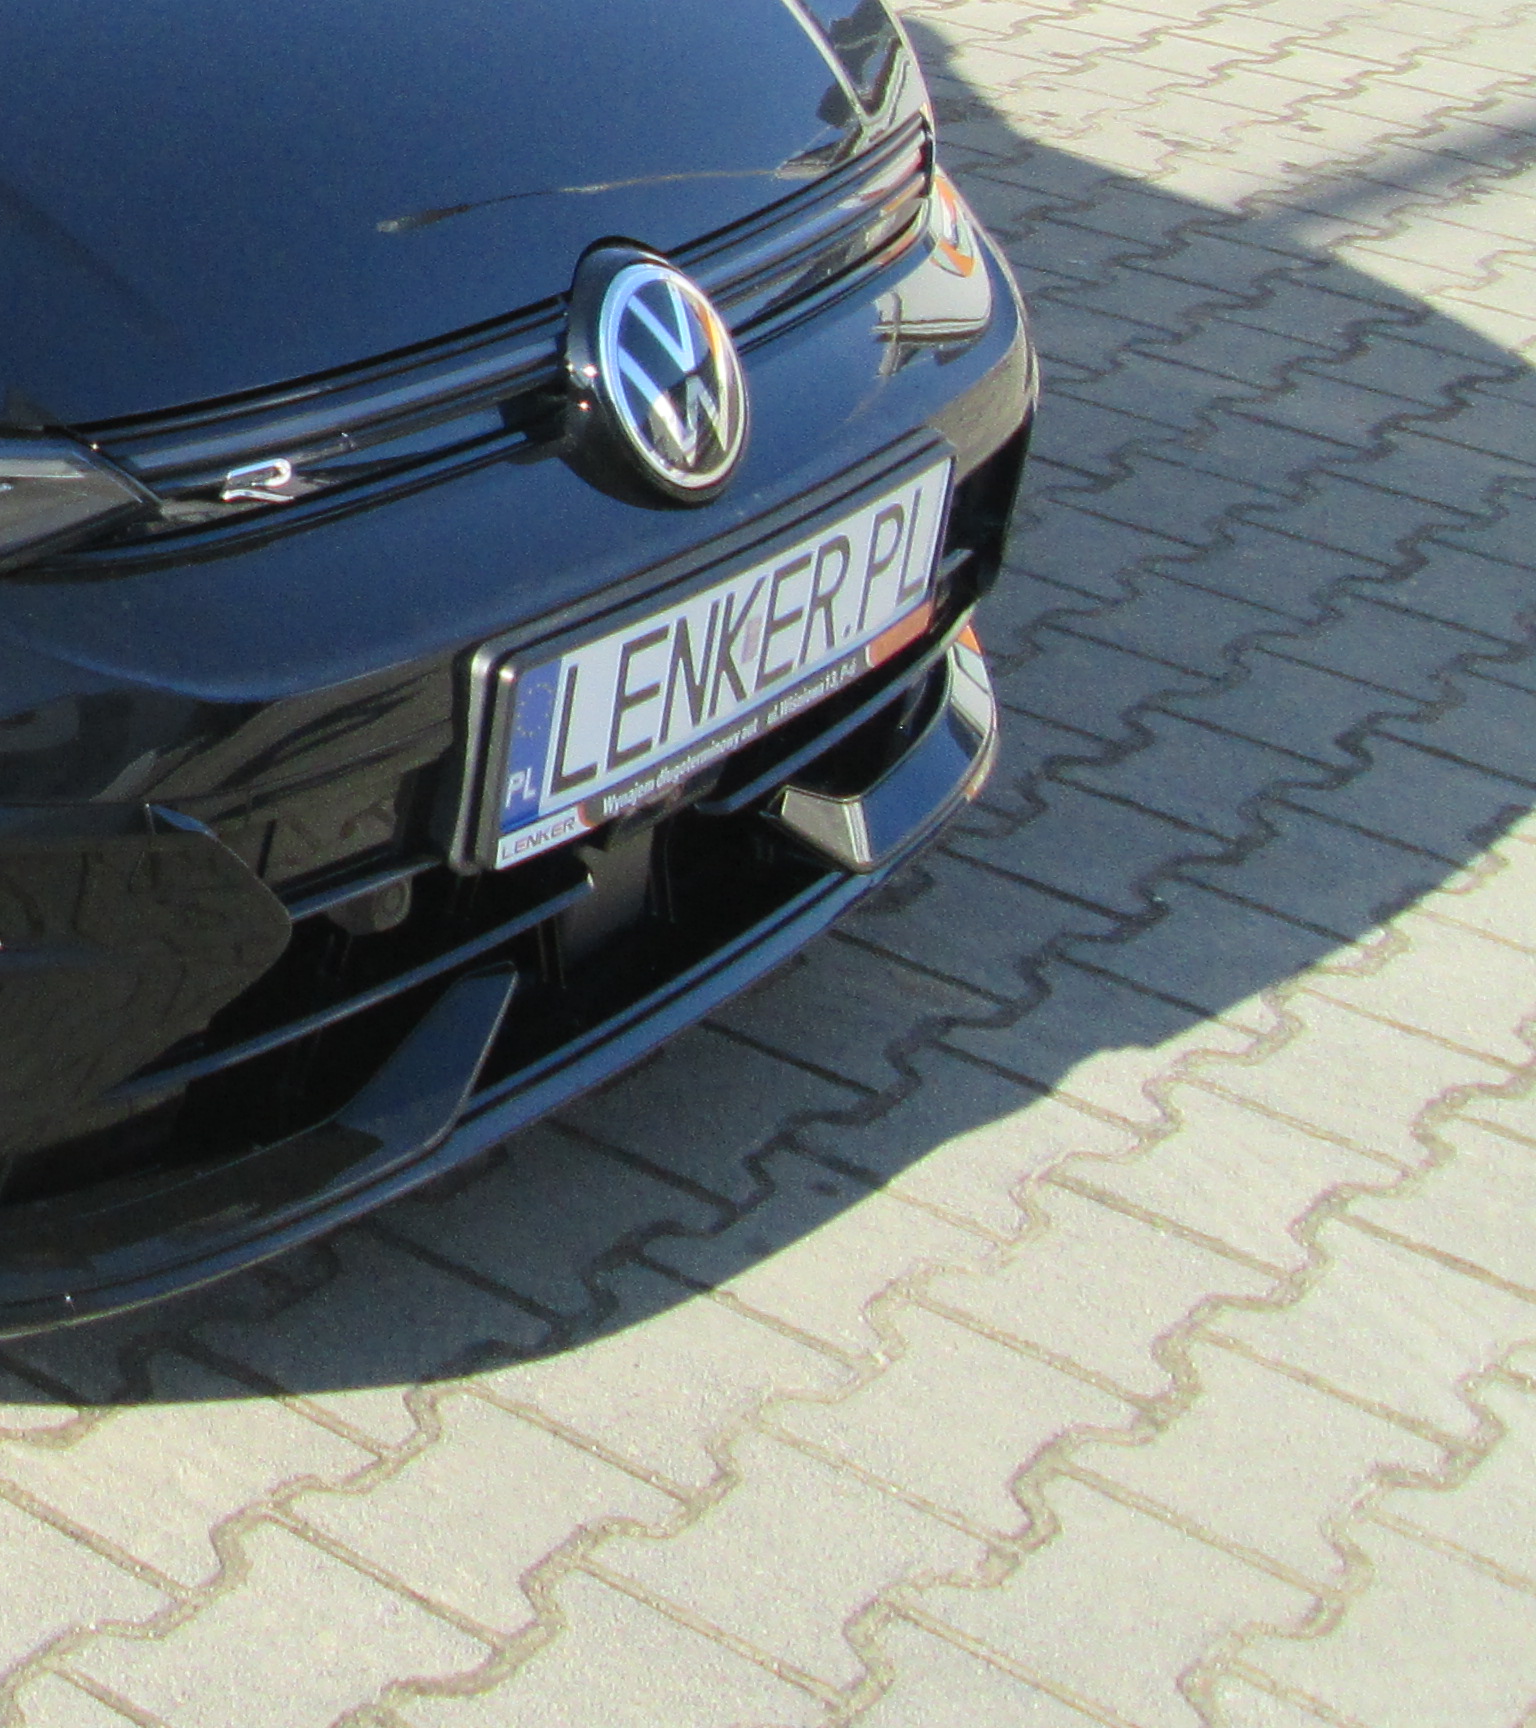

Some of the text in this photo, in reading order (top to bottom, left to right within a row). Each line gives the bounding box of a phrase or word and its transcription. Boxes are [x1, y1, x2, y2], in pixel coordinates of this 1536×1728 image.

[549, 485, 928, 797] LENKER.PL
[505, 767, 536, 809] PL
[602, 779, 655, 817] Wynajem
[501, 815, 576, 860] LENKER
